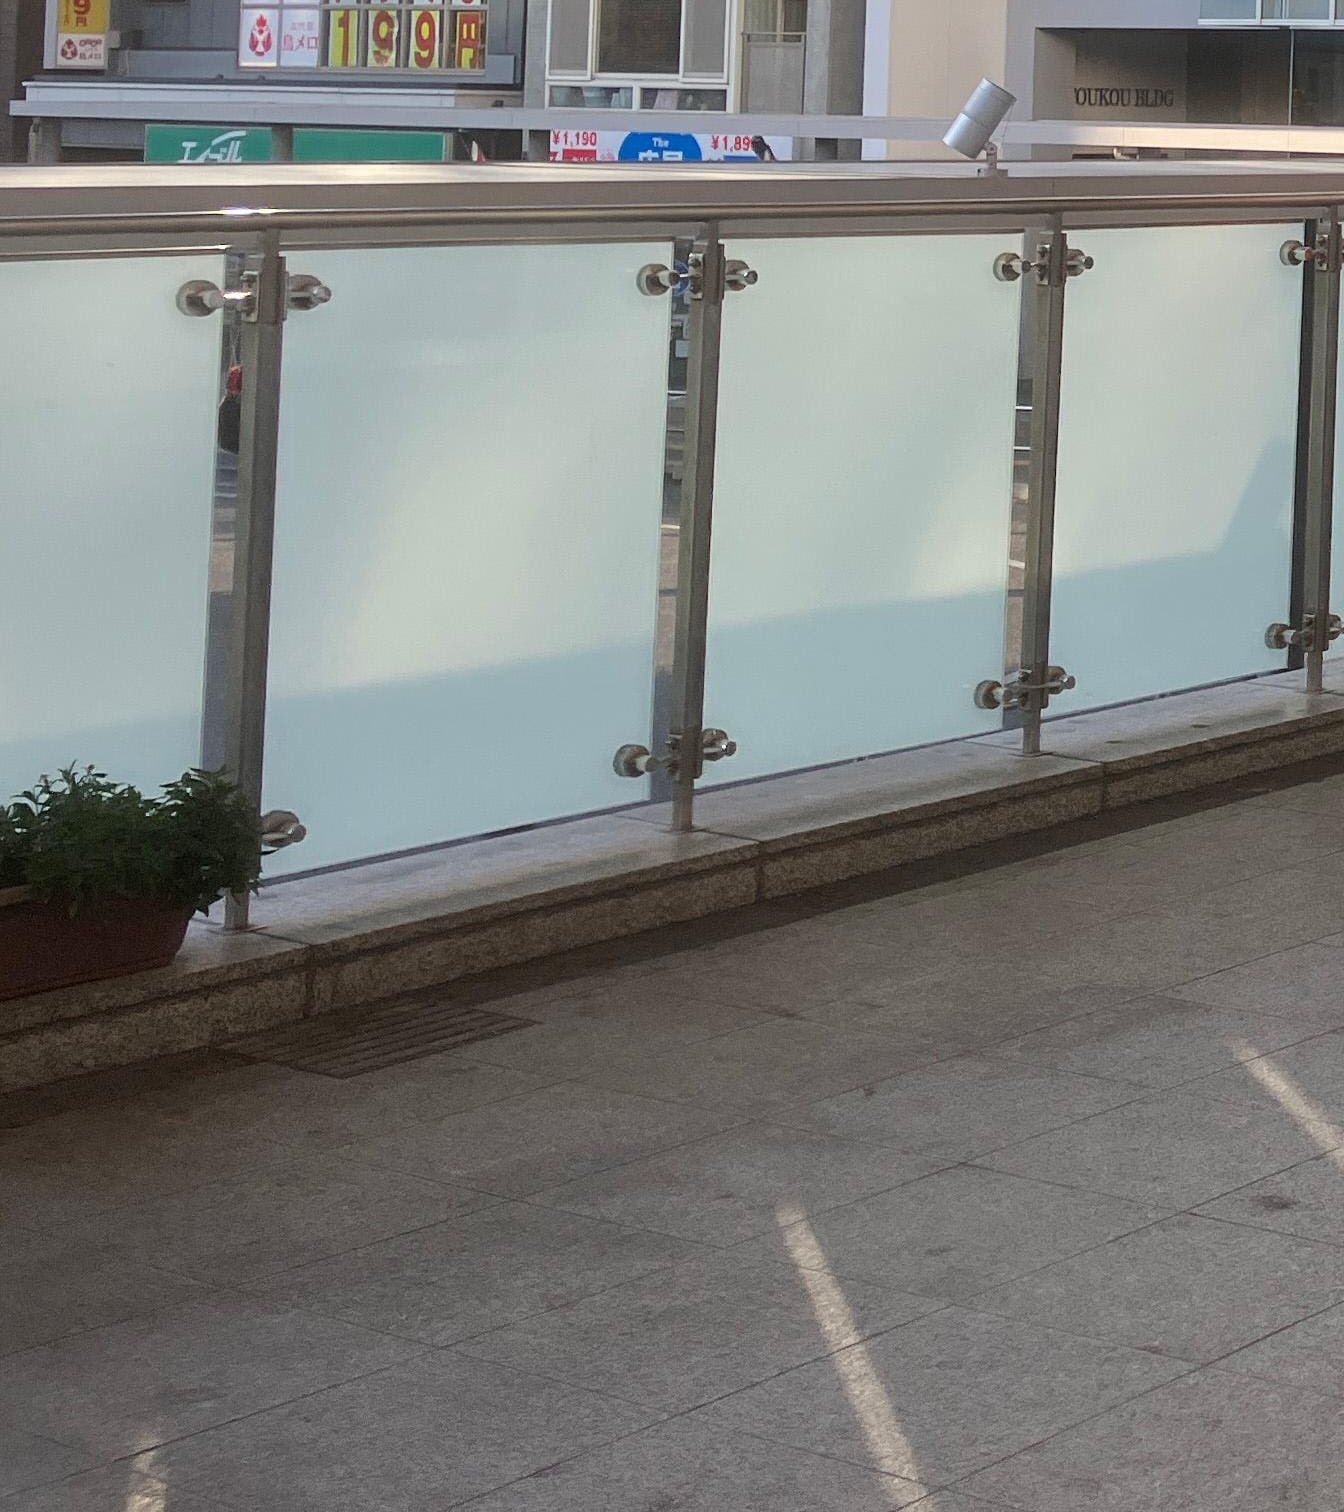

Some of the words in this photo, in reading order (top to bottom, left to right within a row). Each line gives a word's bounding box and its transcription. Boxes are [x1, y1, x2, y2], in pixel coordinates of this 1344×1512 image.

[337, 10, 481, 69] 199円
[552, 130, 597, 147] ¥1,190
[711, 135, 753, 152] ¥1,89
